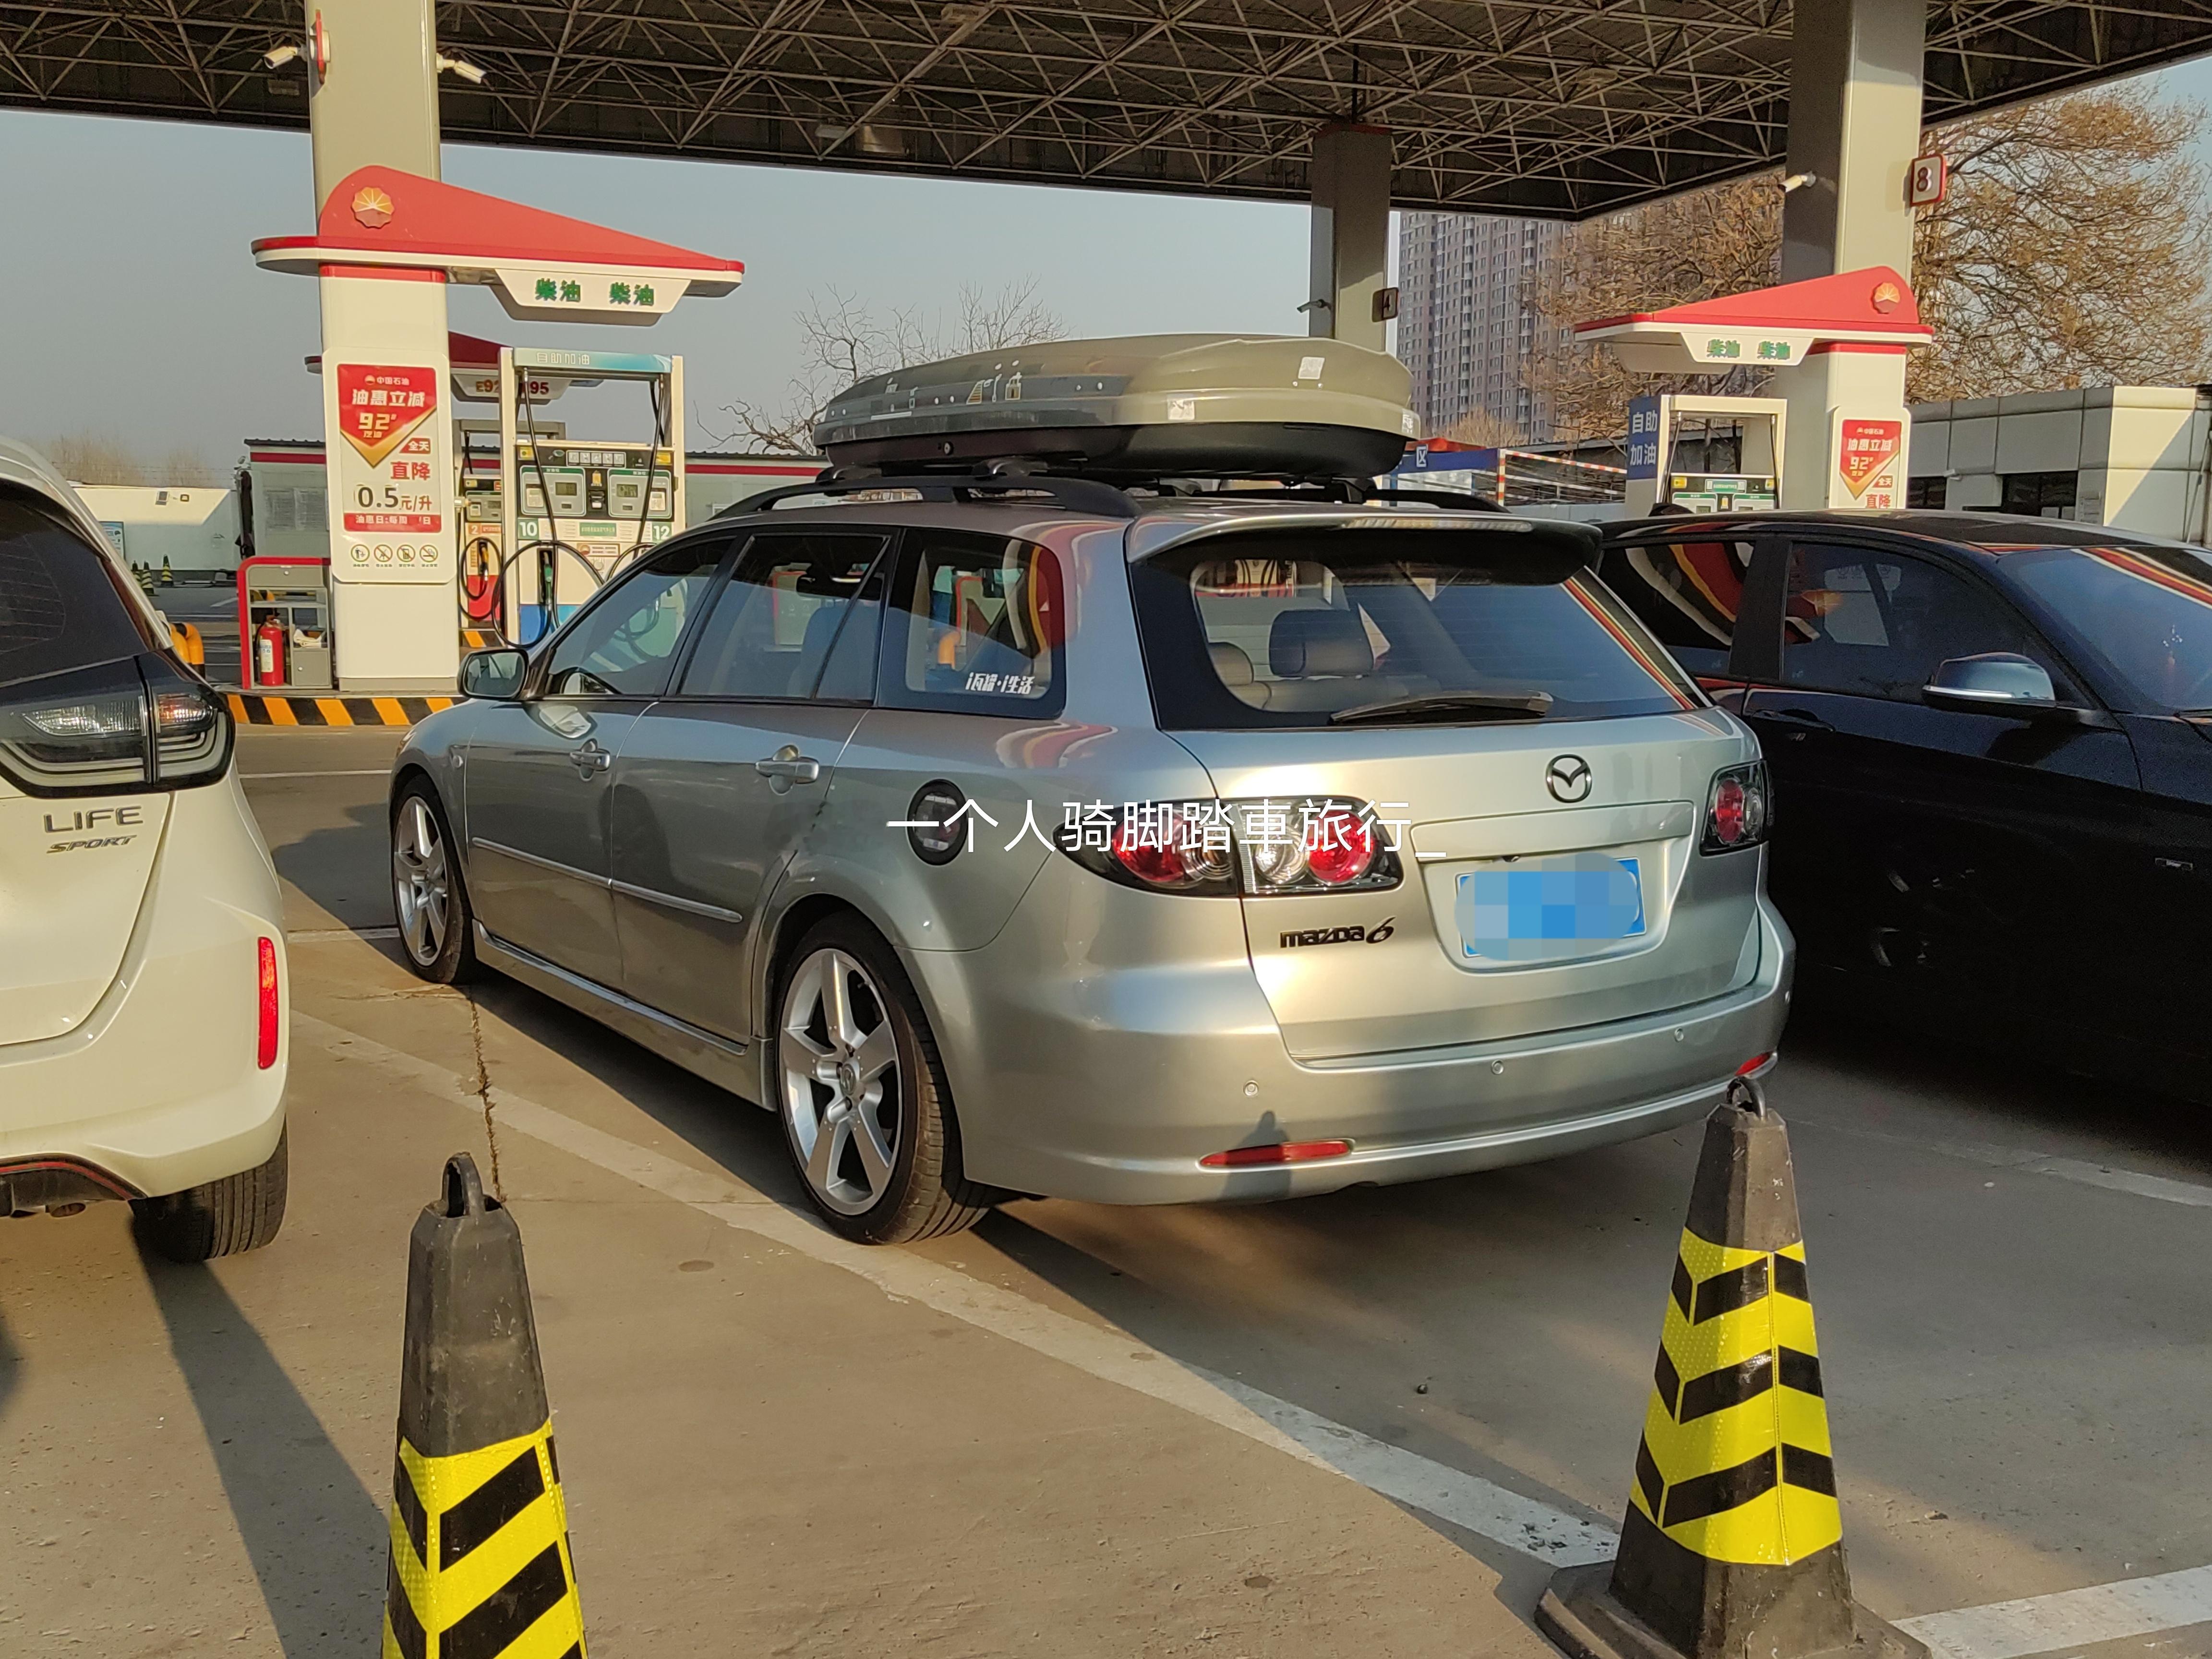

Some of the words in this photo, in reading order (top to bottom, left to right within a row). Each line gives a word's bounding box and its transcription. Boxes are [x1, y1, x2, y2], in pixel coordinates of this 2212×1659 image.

[1916, 167, 1931, 192] 8
[535, 278, 581, 302] 柴油
[609, 282, 654, 306] 柴油
[537, 352, 590, 365] 自助加油
[1707, 339, 1741, 358] 柴油
[1757, 341, 1791, 360] 柴油
[376, 376, 410, 385] 中国石油
[521, 381, 549, 395] 95
[352, 389, 425, 407] 油惠立减
[1632, 409, 1658, 434] 自助
[408, 441, 430, 451] 全天
[1630, 442, 1657, 466] 加油
[1416, 444, 1428, 468] 区
[390, 461, 431, 481] 直降
[1878, 478, 1892, 486] 全天
[1865, 493, 1891, 509] 直降
[471, 525, 479, 534] 2
[519, 522, 537, 537] 10
[653, 526, 670, 540] 12
[43, 805, 144, 833] LIFE
[46, 834, 137, 854] SPORT
